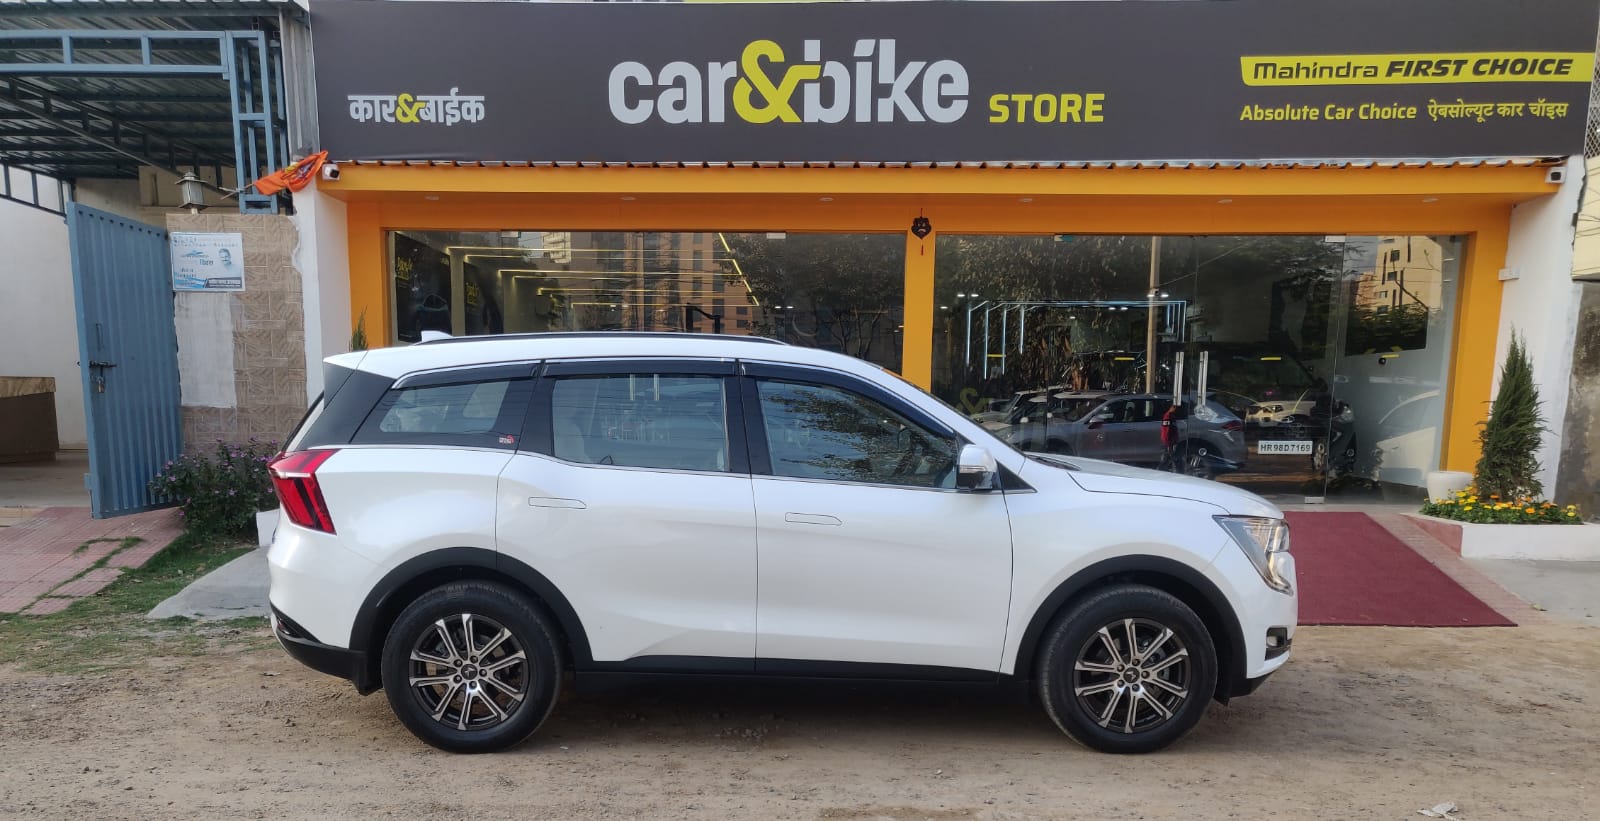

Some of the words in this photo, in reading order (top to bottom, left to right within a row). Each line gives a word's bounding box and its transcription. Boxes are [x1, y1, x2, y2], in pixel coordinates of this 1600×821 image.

[1253, 61, 1379, 80] Mahindra
[1385, 59, 1469, 78] FIRST
[1471, 58, 1574, 77] CHOICE
[608, 39, 969, 125] car&bike
[988, 93, 1105, 124] STORE
[347, 87, 486, 126] कार&बाईक
[1240, 103, 1320, 122] Absolute
[1324, 104, 1355, 121] Car
[1358, 102, 1418, 120] Choice
[1496, 102, 1525, 118] कार
[1528, 98, 1569, 120] चॉइस
